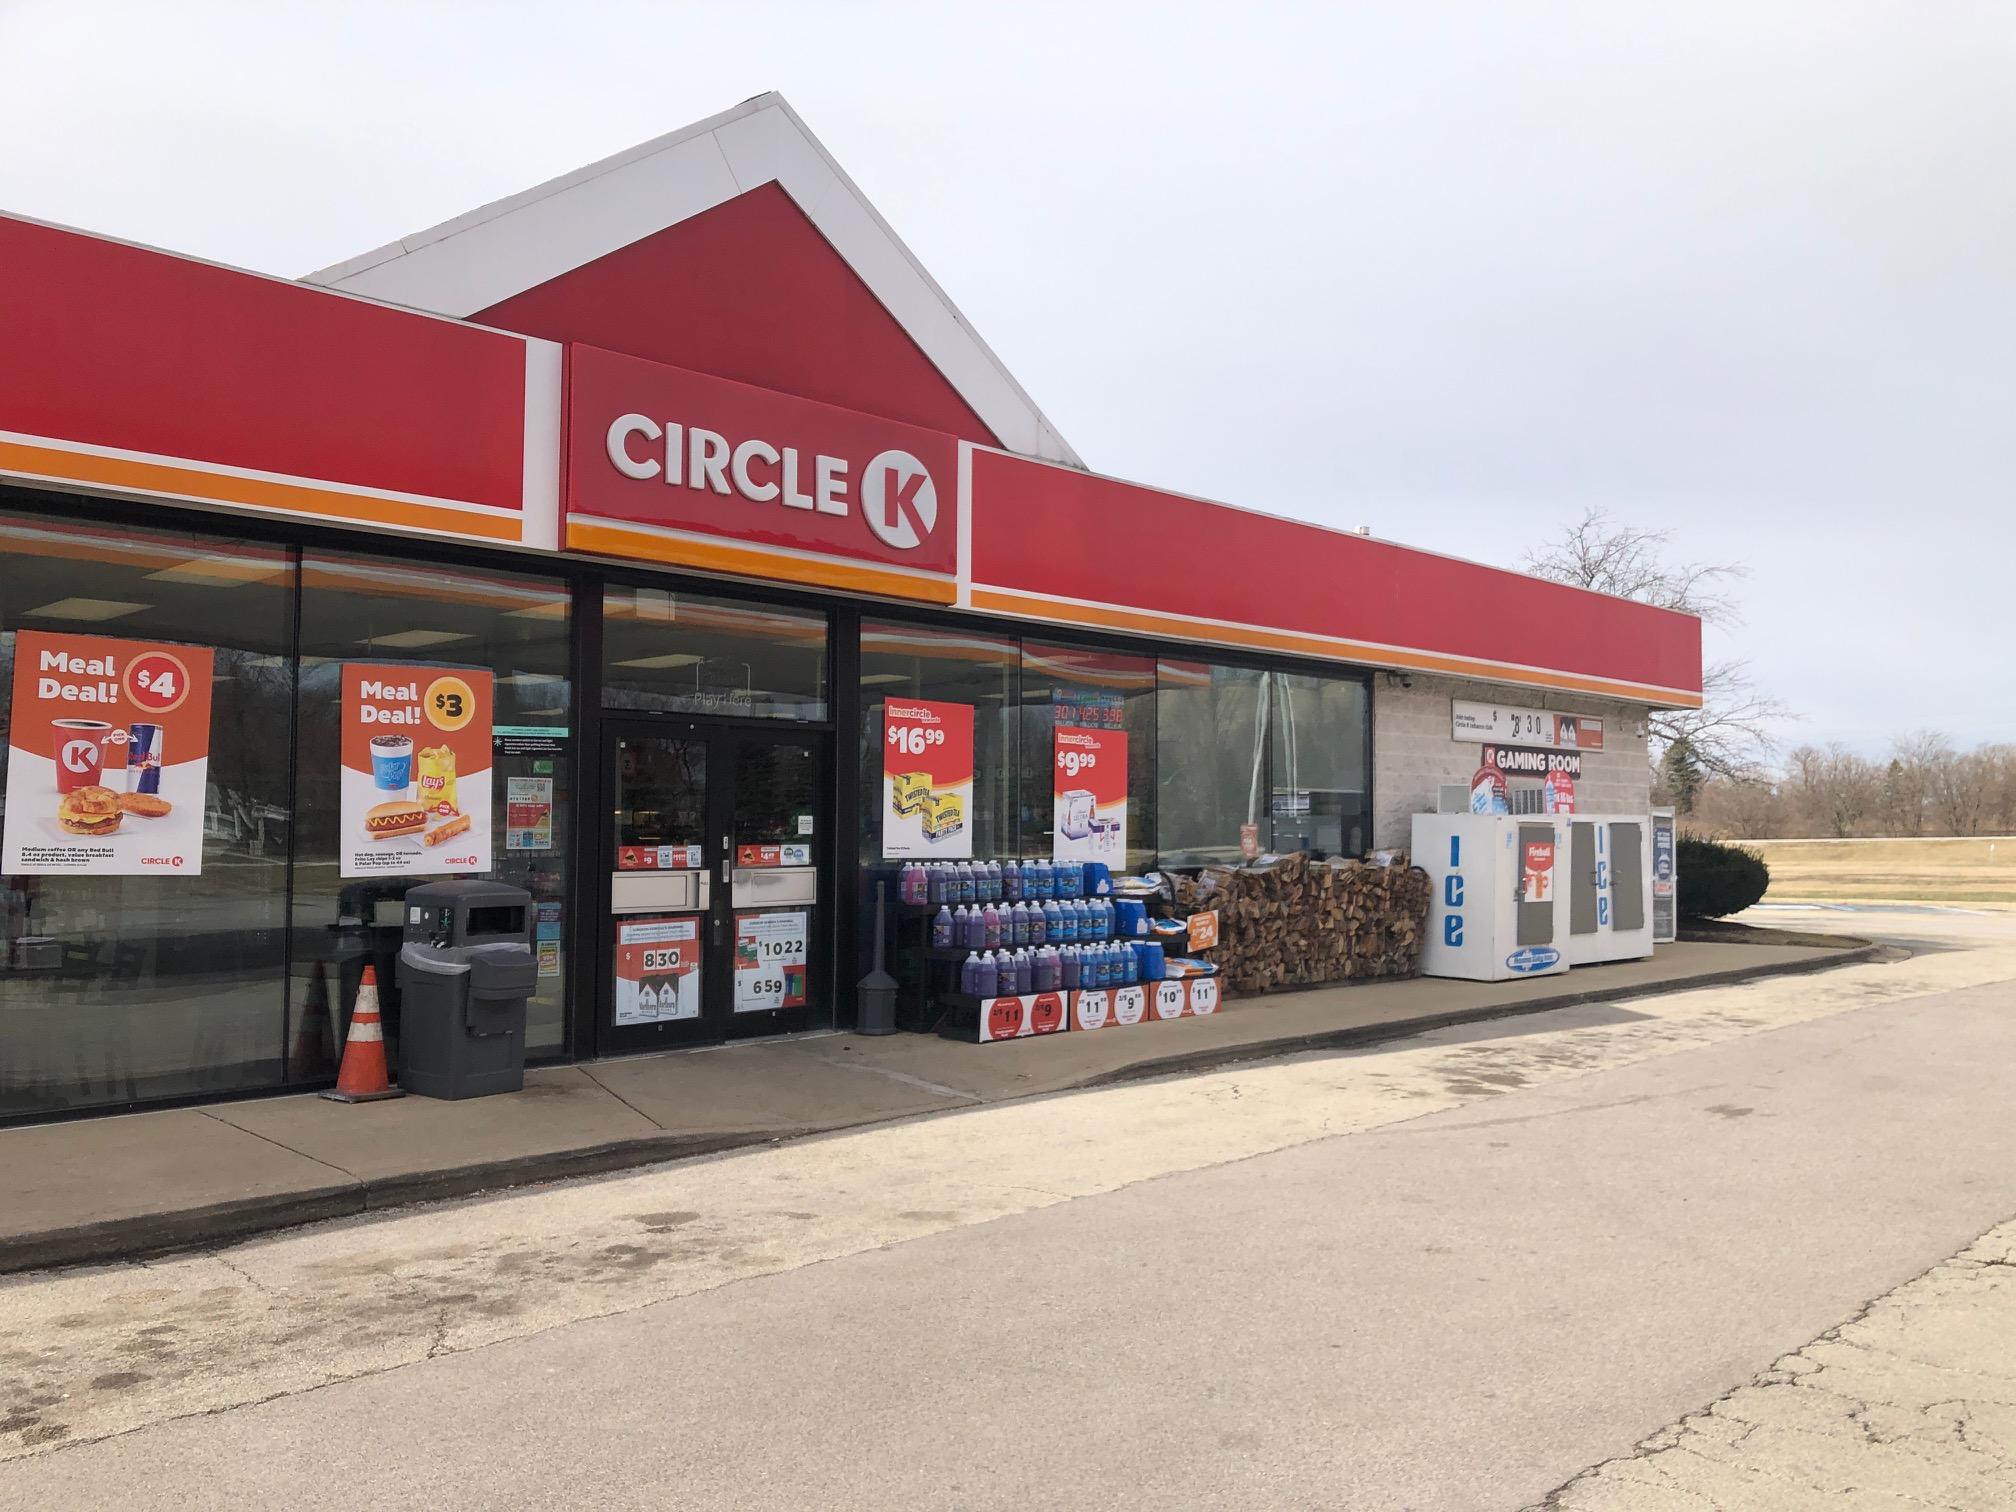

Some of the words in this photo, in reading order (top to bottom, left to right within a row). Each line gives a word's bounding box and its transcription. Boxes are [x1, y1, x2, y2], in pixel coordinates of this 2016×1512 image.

[606, 413, 848, 516] CIRCLE
[40, 650, 116, 677] Meal
[38, 678, 118, 704] Deal!
[137, 669, 176, 698] $4
[360, 680, 418, 701] Meal
[436, 694, 463, 717] $3
[889, 705, 931, 718] Innercircle
[360, 704, 421, 725] Deal!
[1493, 710, 1497, 722] $
[1058, 733, 1093, 744] Innercircle
[1496, 750, 1546, 770] GAMING
[1548, 754, 1581, 773] ROOM
[1598, 826, 1608, 925] Ice
[1444, 835, 1464, 947] Ice
[644, 952, 678, 967] 830
[754, 980, 782, 994] 659
[1197, 988, 1208, 1000] 11
[1128, 997, 1134, 1009] 9
[1164, 992, 1176, 1003] 10
[1044, 1004, 1051, 1016] 9
[1086, 1001, 1098, 1013] 11
[1005, 1010, 1018, 1022] 11
